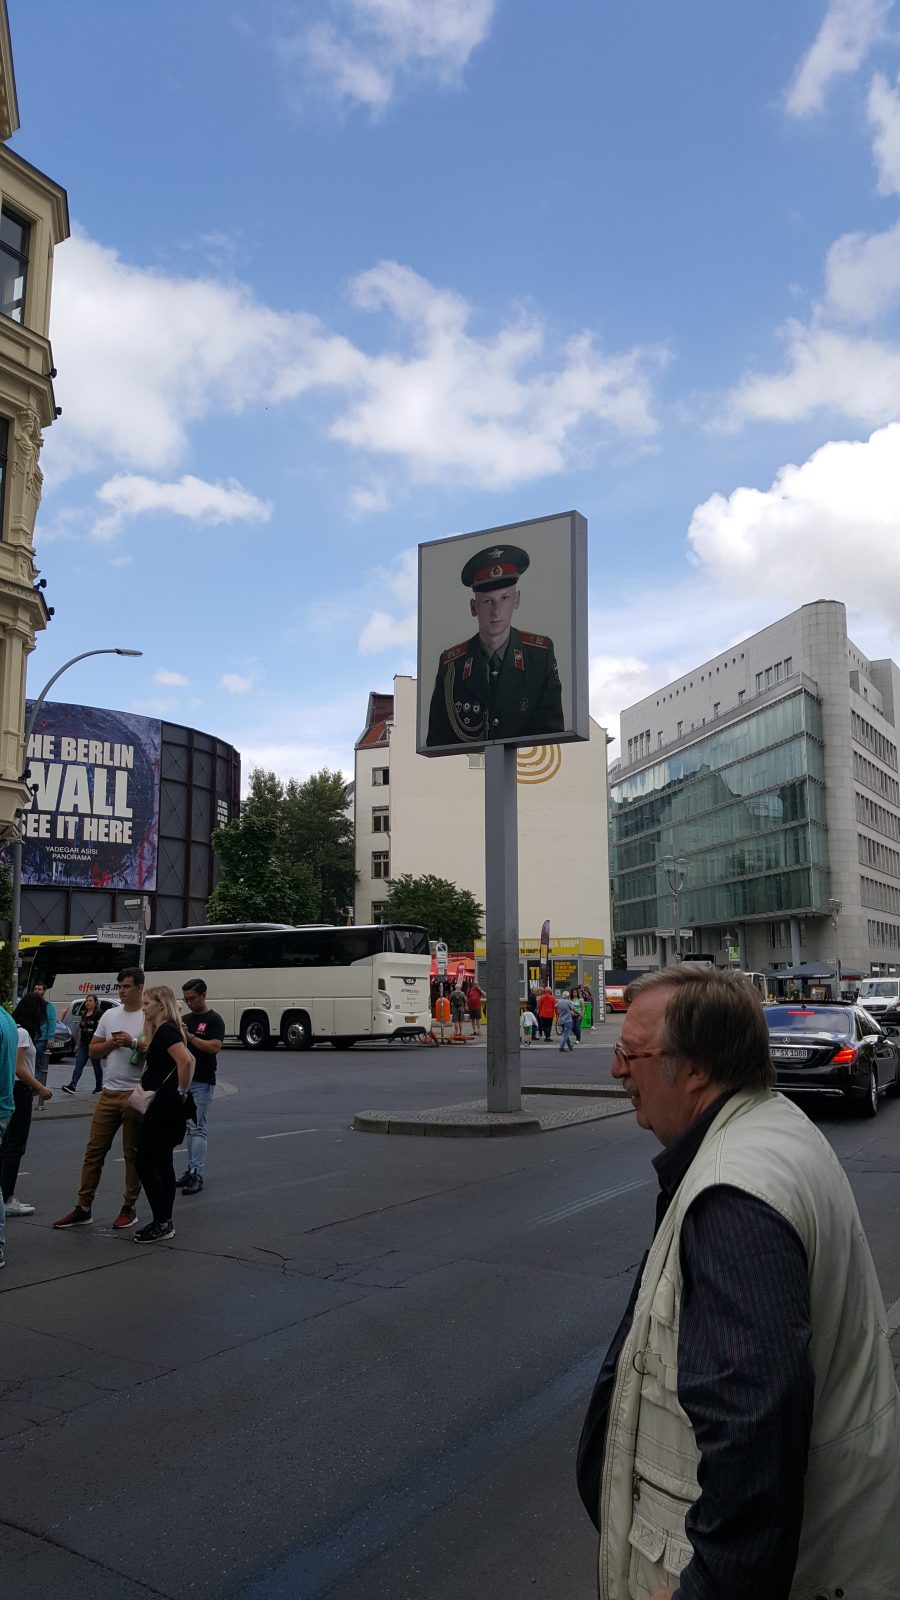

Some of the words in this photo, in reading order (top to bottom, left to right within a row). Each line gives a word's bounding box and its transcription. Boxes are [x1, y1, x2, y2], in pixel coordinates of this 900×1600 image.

[26, 733, 55, 760] HE
[60, 736, 134, 769] BERLIN
[24, 761, 133, 818] WALL
[56, 815, 79, 839] IT
[83, 817, 133, 844] HERE
[45, 845, 79, 854] YADEGAR
[80, 847, 98, 855] ASISI
[52, 853, 92, 861] PANORAMA
[102, 931, 135, 941] Friedrichstraße
[79, 982, 119, 994] effeweg.n
